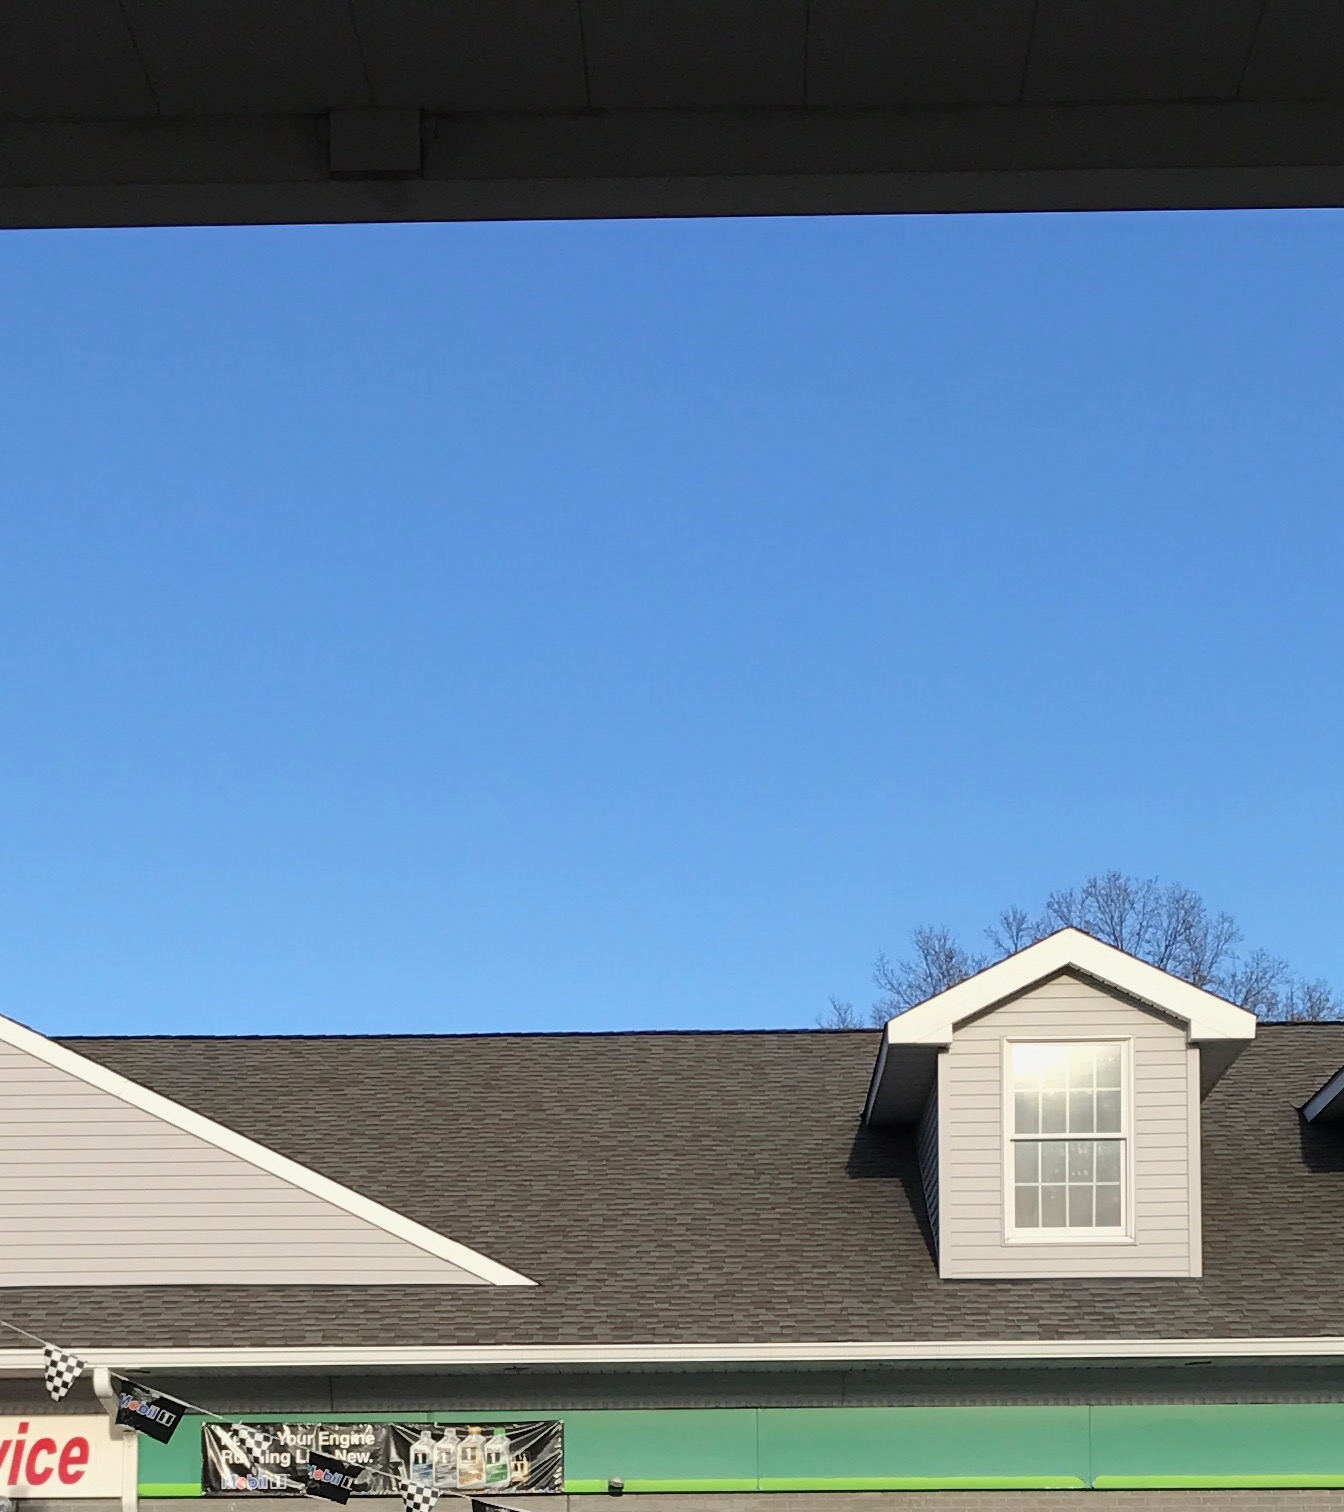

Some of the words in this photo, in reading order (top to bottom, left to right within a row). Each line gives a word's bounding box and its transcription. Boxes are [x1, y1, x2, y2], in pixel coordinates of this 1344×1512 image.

[119, 1393, 160, 1420] Mobil
[278, 1431, 315, 1446] Your
[318, 1431, 375, 1449] Engine
[222, 1450, 291, 1467] Ruing
[335, 1449, 374, 1464] New.
[221, 1474, 267, 1490] Mobil
